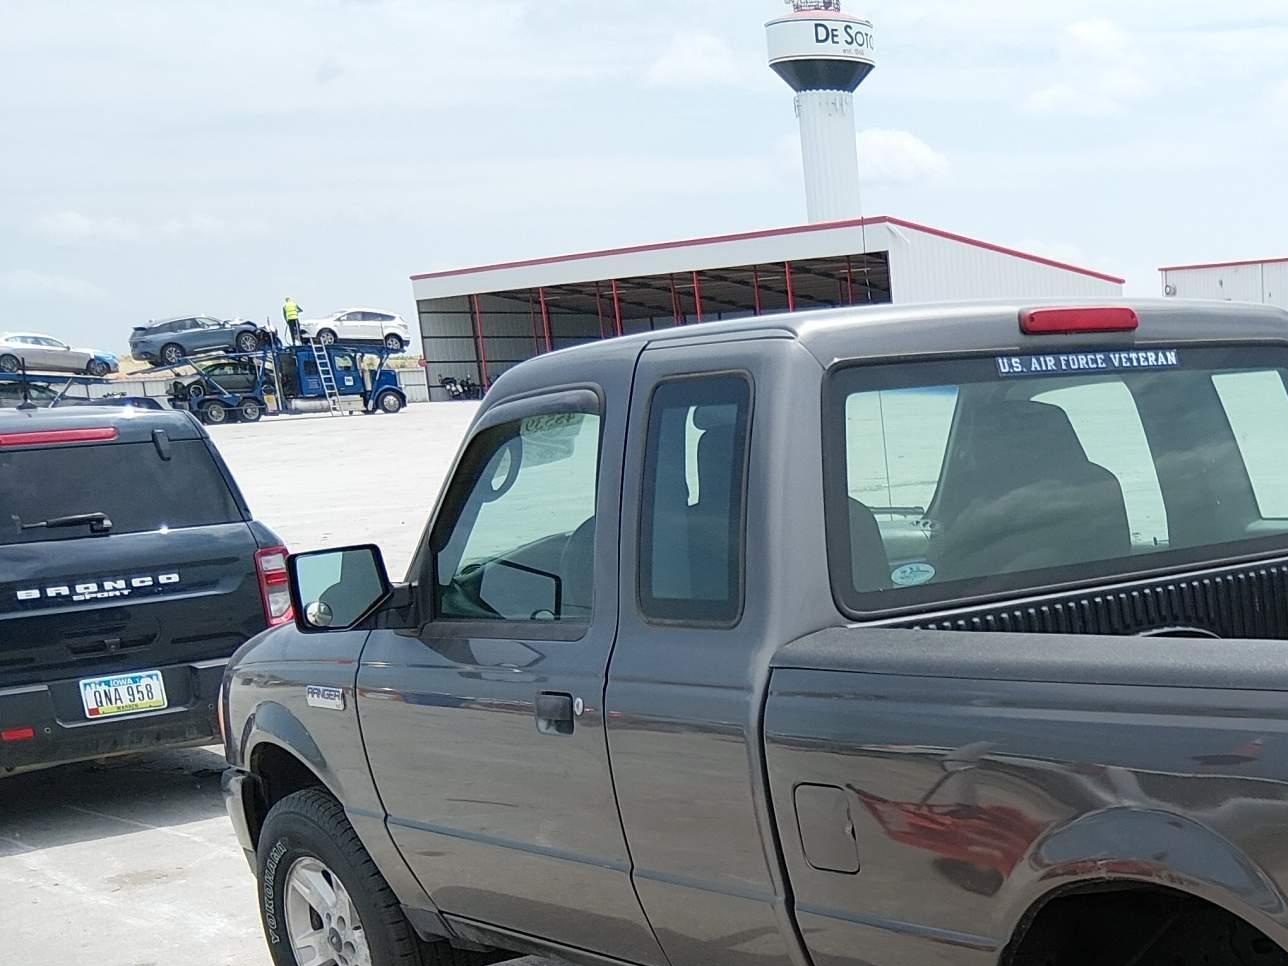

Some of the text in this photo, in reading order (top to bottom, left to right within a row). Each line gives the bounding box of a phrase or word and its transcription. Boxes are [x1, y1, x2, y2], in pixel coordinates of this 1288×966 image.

[814, 23, 840, 44] DE
[998, 351, 1177, 373] U.S. AIR FORCE VETERAN
[16, 573, 180, 600] BRONCO
[72, 589, 132, 601] SPORT
[109, 677, 134, 688] IOWA
[93, 683, 155, 708] QNA 958
[307, 686, 341, 702] RANGER
[263, 840, 288, 945] YOKOHAMA
